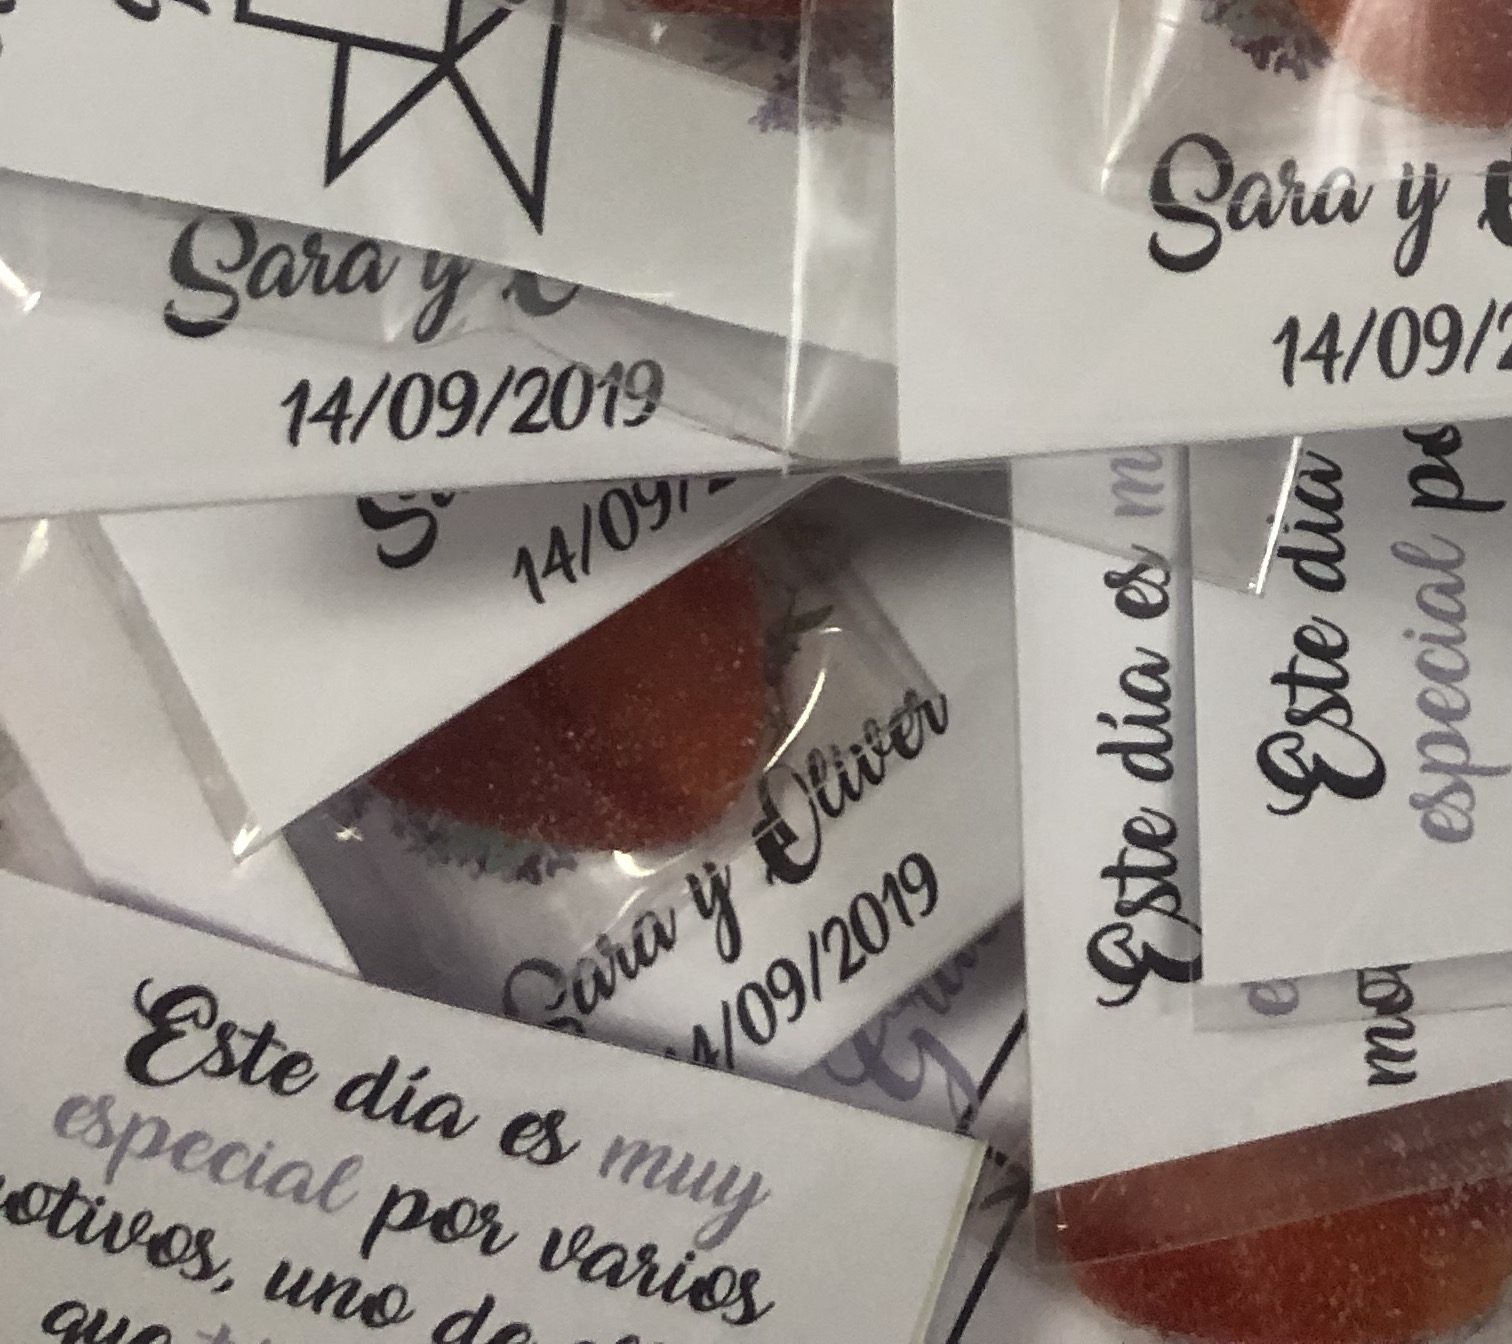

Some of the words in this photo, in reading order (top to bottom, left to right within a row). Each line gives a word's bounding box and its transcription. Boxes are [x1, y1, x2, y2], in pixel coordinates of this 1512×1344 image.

[161, 210, 392, 338] Sara
[1147, 131, 1374, 273] Sara
[1391, 165, 1449, 278] y
[280, 358, 665, 447] 14/09/2019
[1404, 424, 1505, 516] po
[1104, 543, 1172, 619] es
[1277, 451, 1347, 593] día
[1096, 647, 1177, 782] día
[1256, 615, 1388, 816] Este
[1390, 532, 1512, 846] especial
[688, 860, 742, 964] y
[756, 688, 950, 887] Oliver
[1085, 807, 1204, 1008] Este
[124, 976, 317, 1096] Este
[333, 1054, 478, 1142] día
[500, 1104, 582, 1168] es
[600, 1132, 772, 1250] muy
[54, 1090, 366, 1214] especial
[360, 1180, 518, 1260] por
[539, 1221, 774, 1326] varios
[264, 1256, 414, 1330] uno
